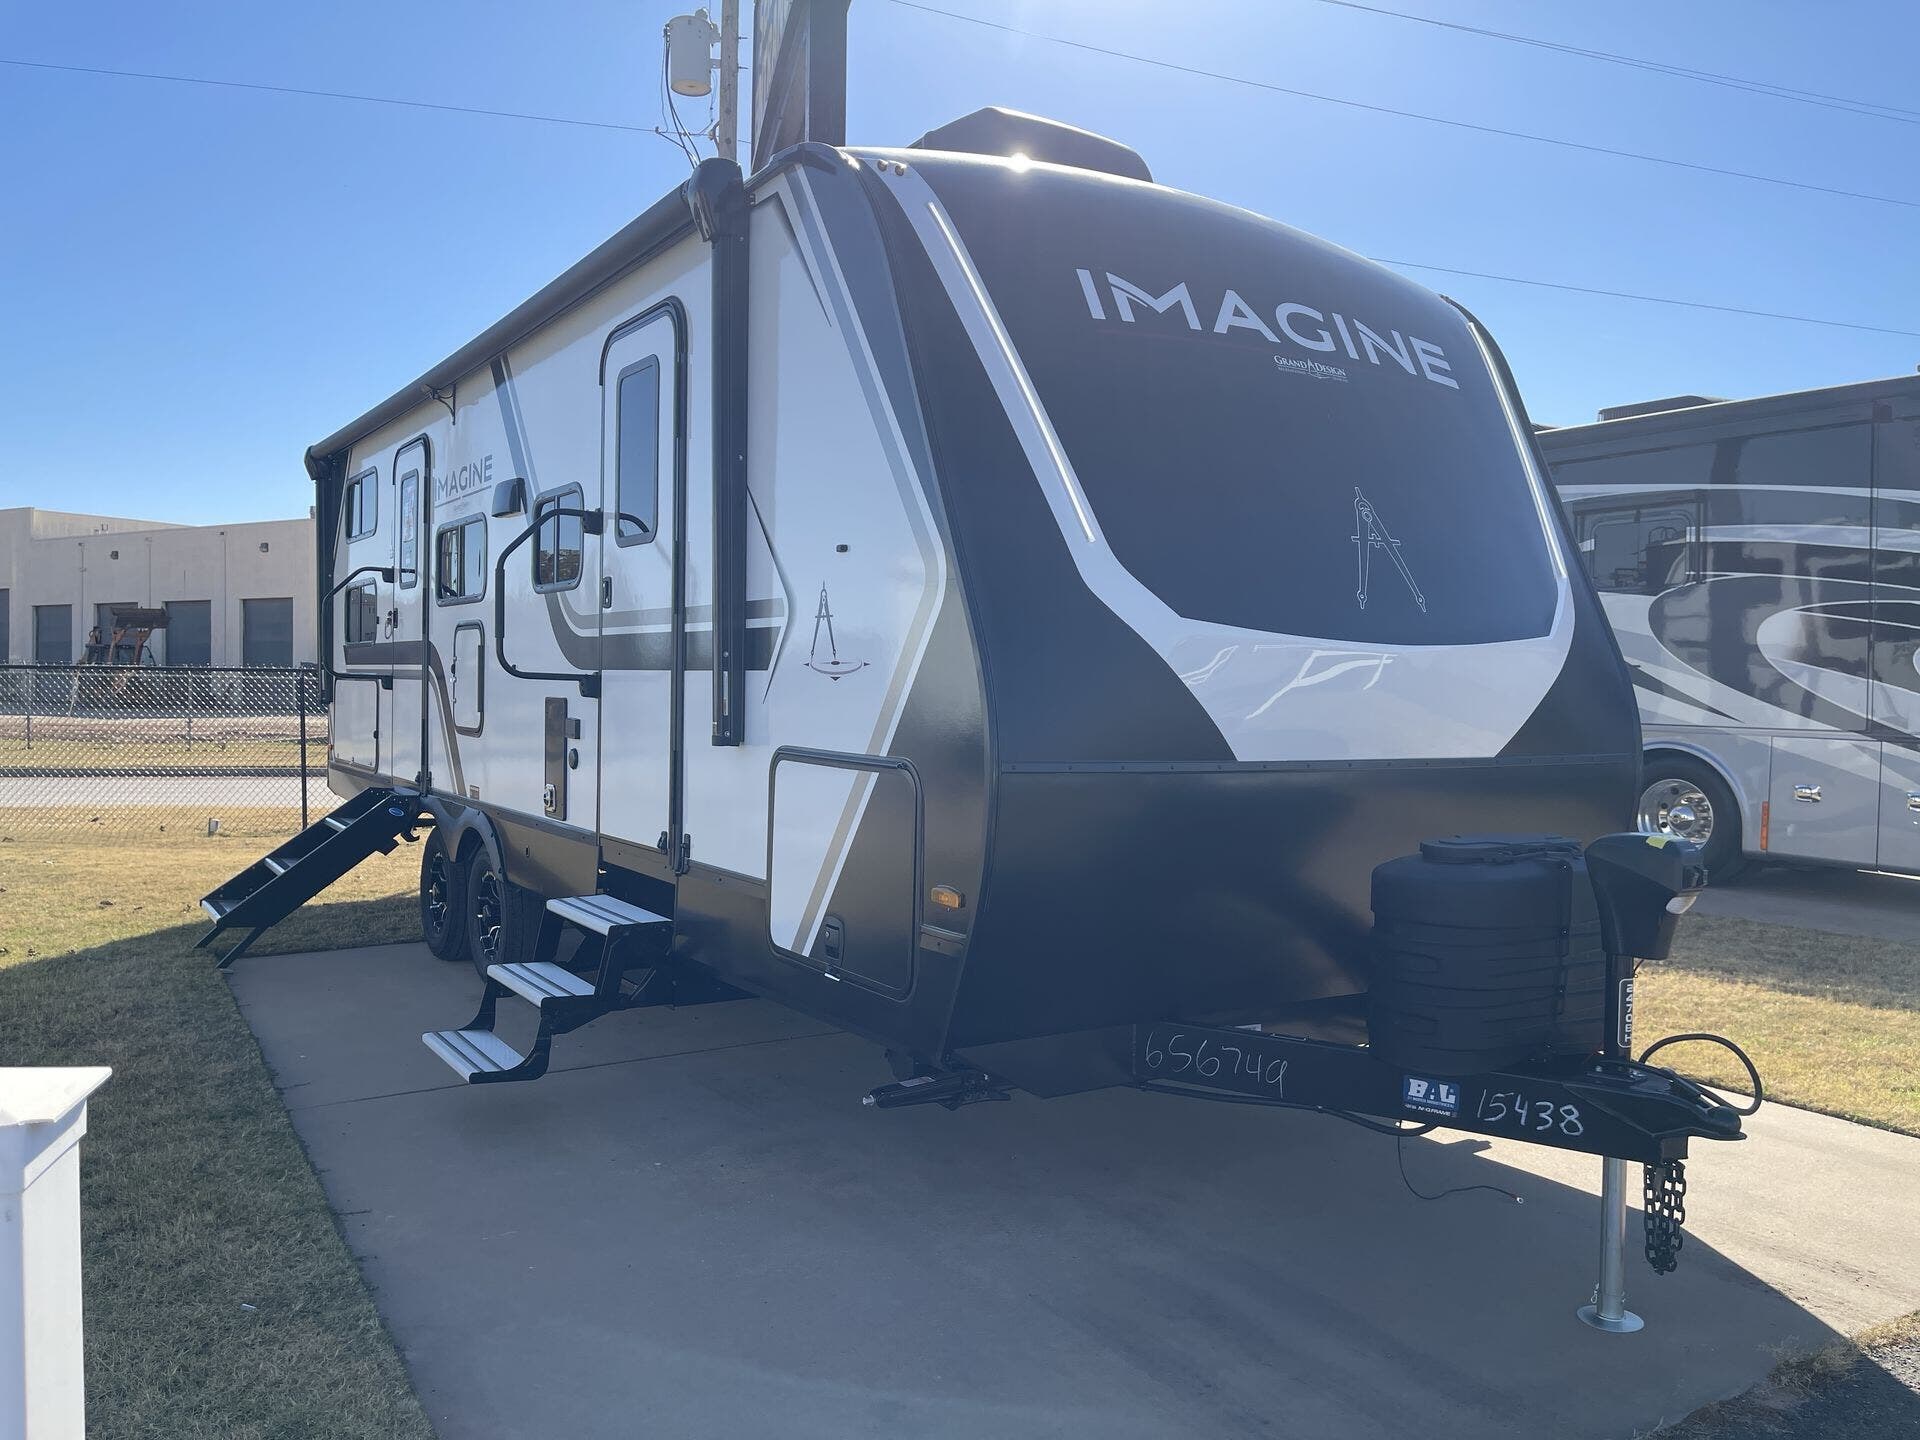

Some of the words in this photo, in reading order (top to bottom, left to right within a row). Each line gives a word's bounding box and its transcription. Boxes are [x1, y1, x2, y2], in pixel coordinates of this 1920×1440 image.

[1076, 268, 1460, 390] IMAGINE
[434, 454, 493, 502] IMAGINE
[1146, 1031, 1288, 1099] 656749
[1477, 1088, 1584, 1136] 15438
